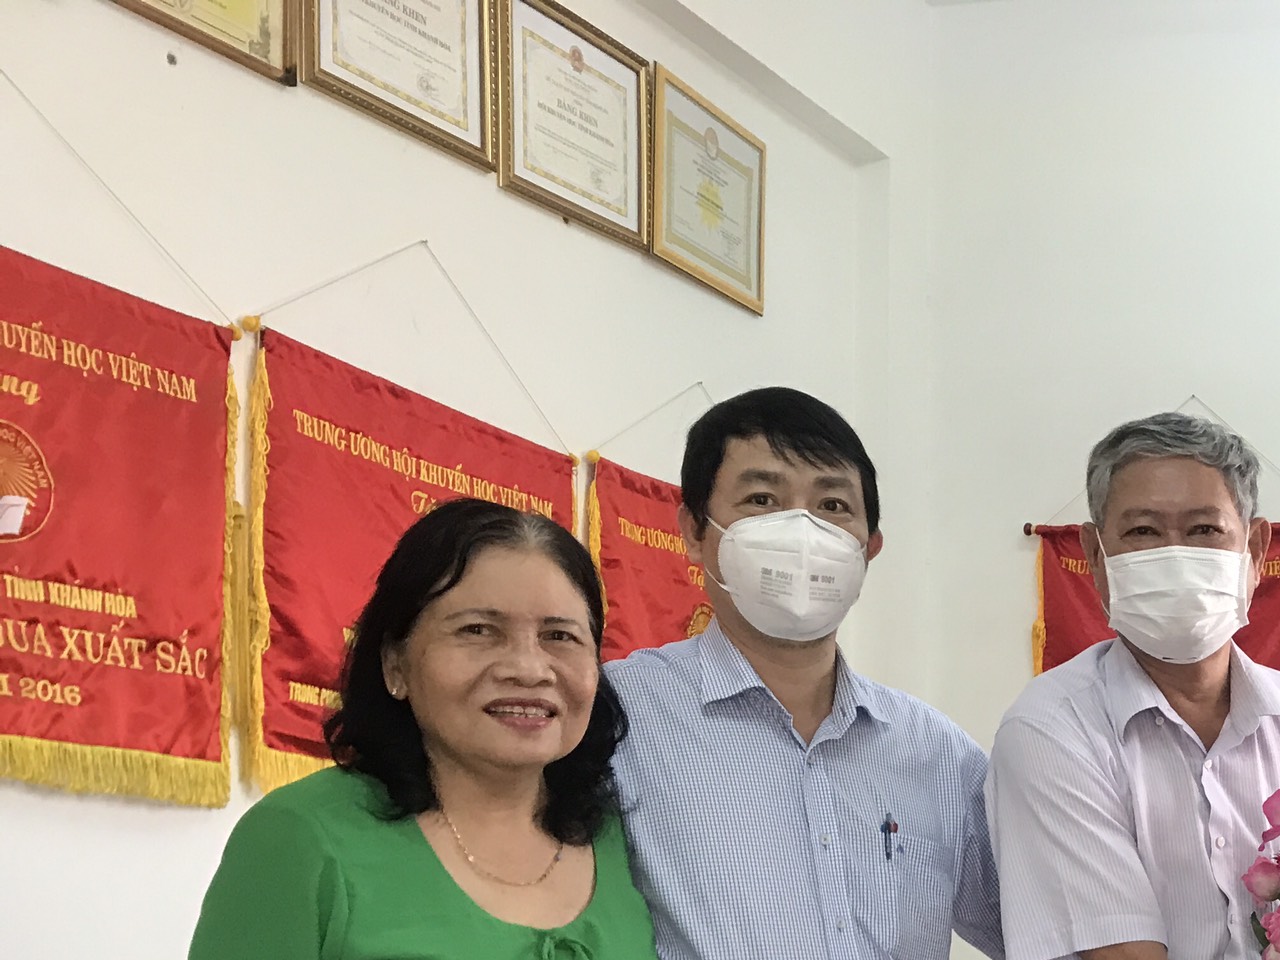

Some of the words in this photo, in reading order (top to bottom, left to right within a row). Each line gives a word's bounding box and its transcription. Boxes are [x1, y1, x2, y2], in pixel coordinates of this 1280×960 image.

[0, 320, 56, 362] UYẾN
[61, 338, 103, 377] HỌC
[107, 351, 152, 391] VIỆT
[155, 368, 197, 402] NAM
[0, 373, 41, 405] ng
[293, 409, 348, 452] TRUNG
[349, 432, 390, 468] ƯƠNG
[392, 447, 417, 481] HỘI
[419, 459, 471, 495] KHUYẾN
[618, 517, 646, 545] TRUNG
[674, 532, 689, 560] HỘ
[1060, 556, 1089, 575] TRU
[3, 565, 45, 602] TỈNH
[48, 579, 103, 613] KHÁNH
[104, 587, 138, 618] HÒA
[59, 620, 147, 670] XUẤT
[156, 629, 208, 680] SẮC
[19, 677, 82, 706] 2016
